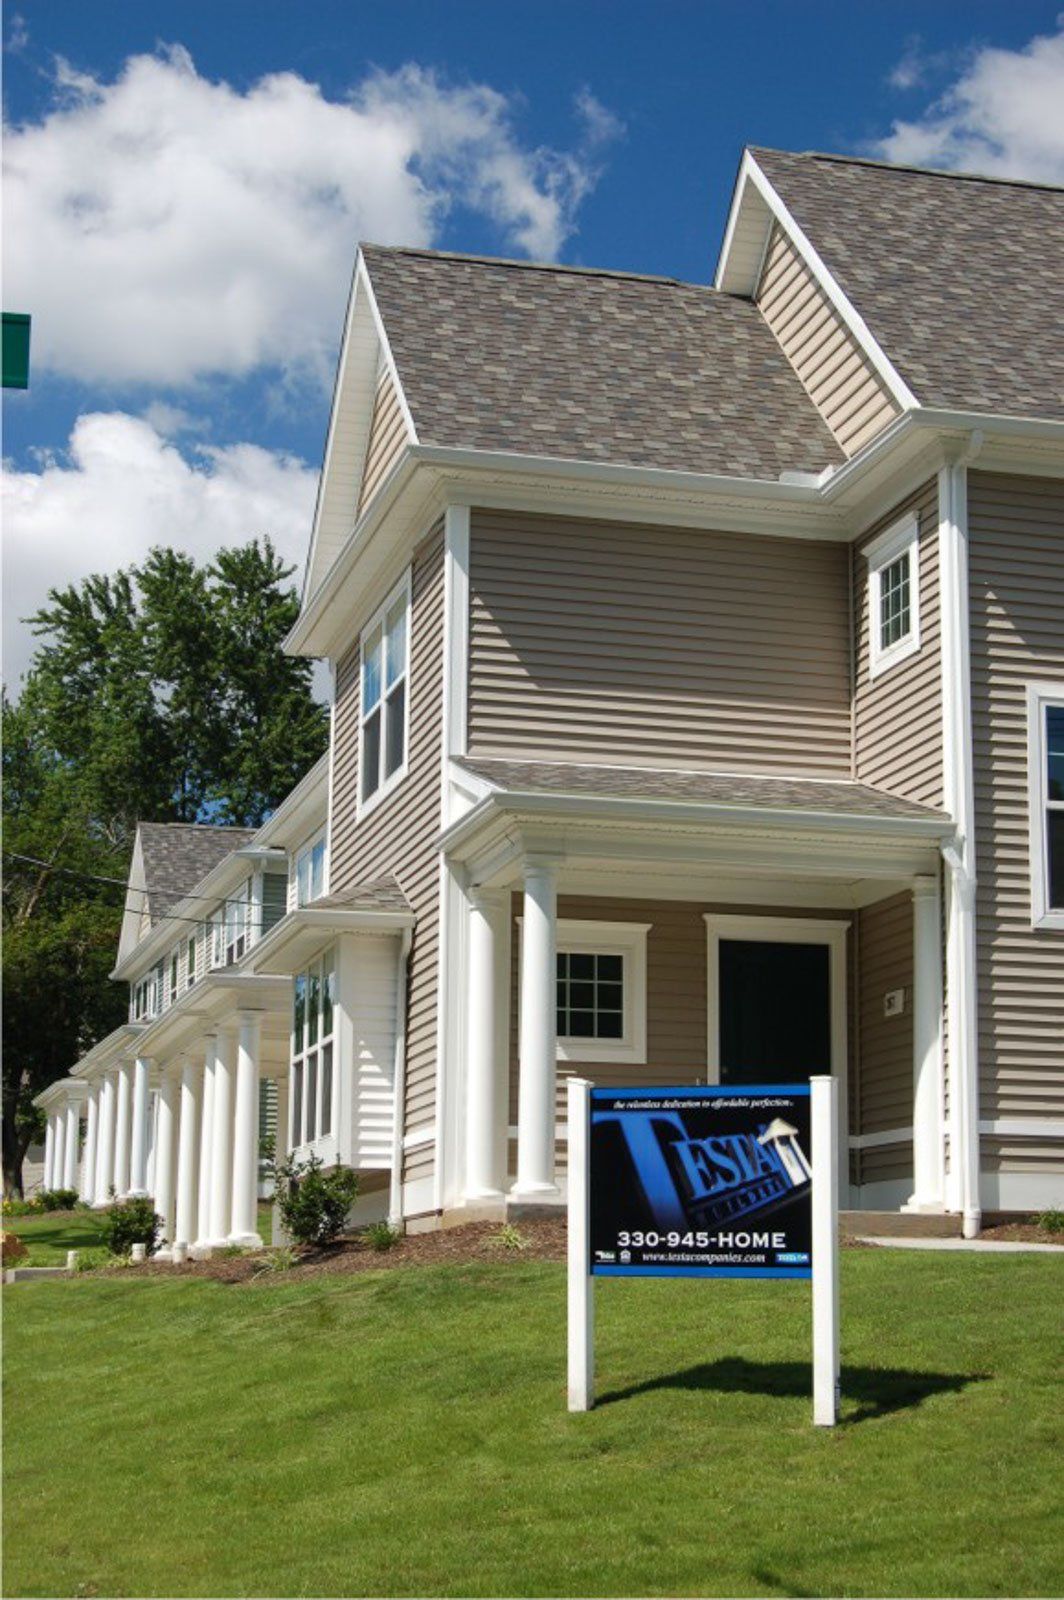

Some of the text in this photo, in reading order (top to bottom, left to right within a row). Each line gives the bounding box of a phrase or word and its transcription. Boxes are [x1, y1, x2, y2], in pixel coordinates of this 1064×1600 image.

[662, 1099, 701, 1108] dedication
[711, 1098, 749, 1110] affordable
[617, 1231, 787, 1249] 330-945-HOME
[642, 1251, 766, 1265] www.testacompanies.com
